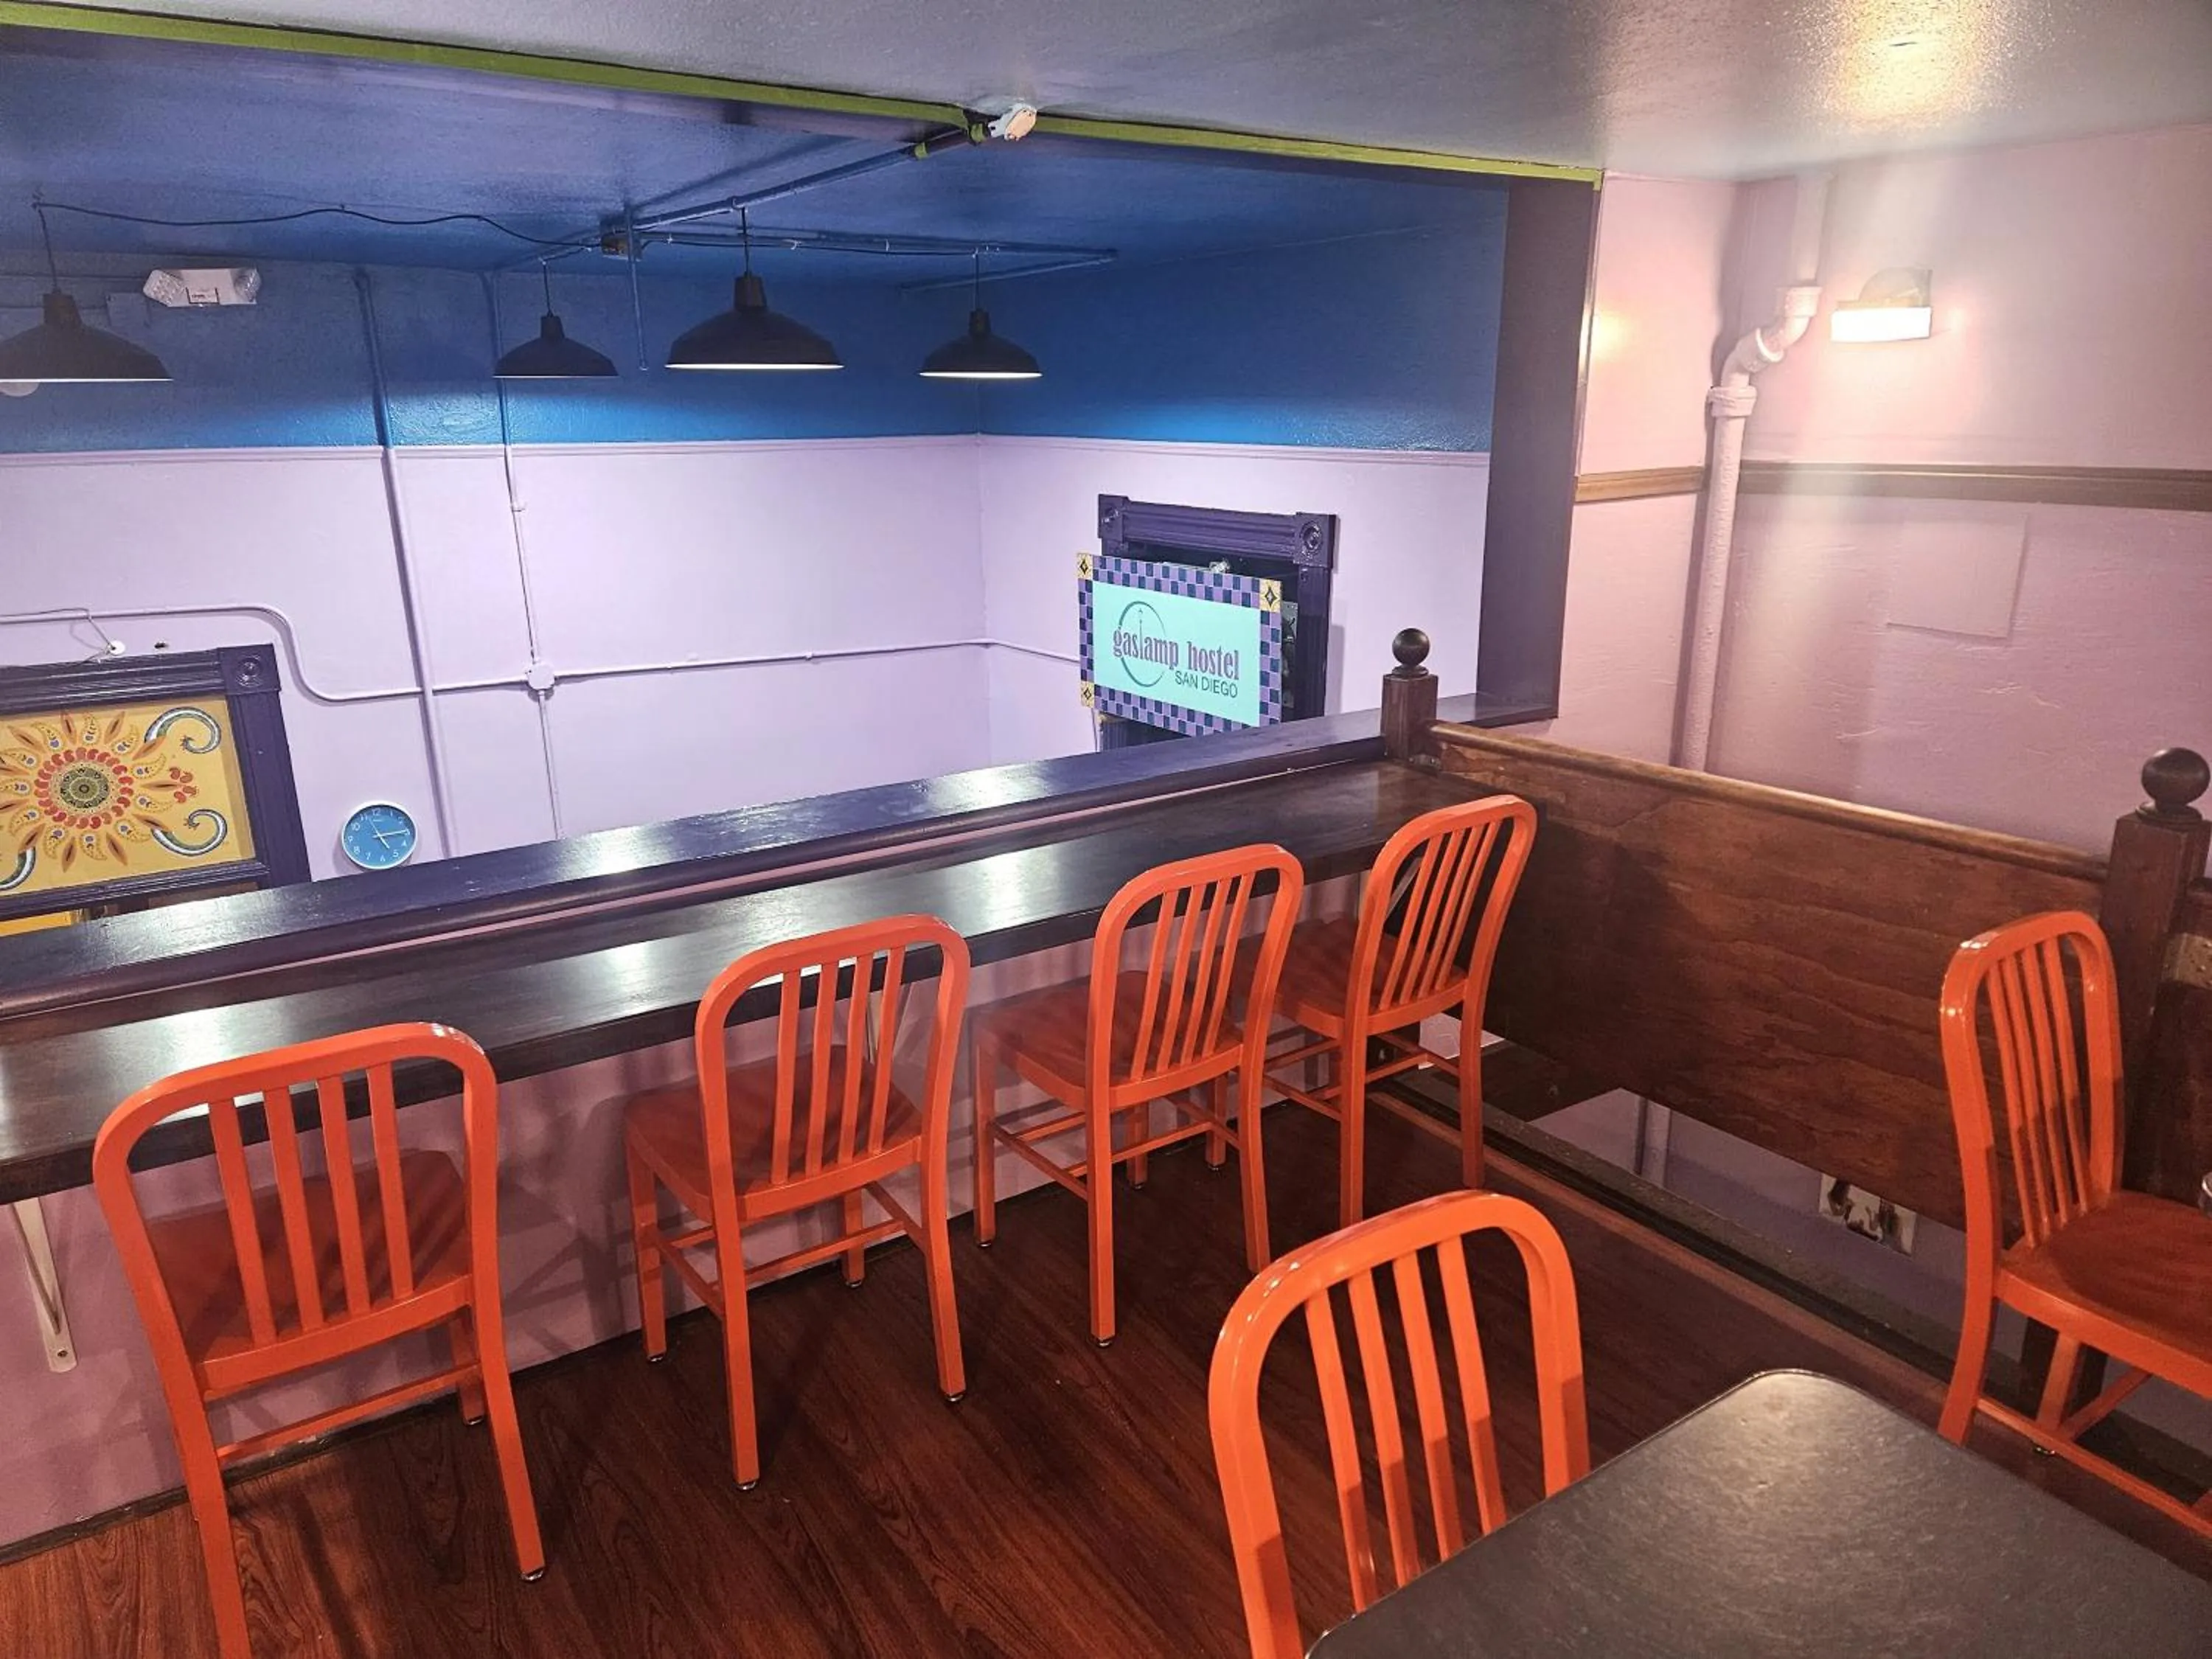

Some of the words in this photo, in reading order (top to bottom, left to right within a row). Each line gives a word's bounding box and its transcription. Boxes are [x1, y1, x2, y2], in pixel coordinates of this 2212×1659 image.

[1113, 621, 1179, 670] gaslamp
[1186, 641, 1239, 681] hostel
[1175, 669, 1199, 689] SAN
[1201, 675, 1238, 699] DIEGO
[372, 807, 381, 816] 12
[360, 813, 368, 821] 11
[350, 822, 361, 832] 10
[392, 849, 398, 858] 5
